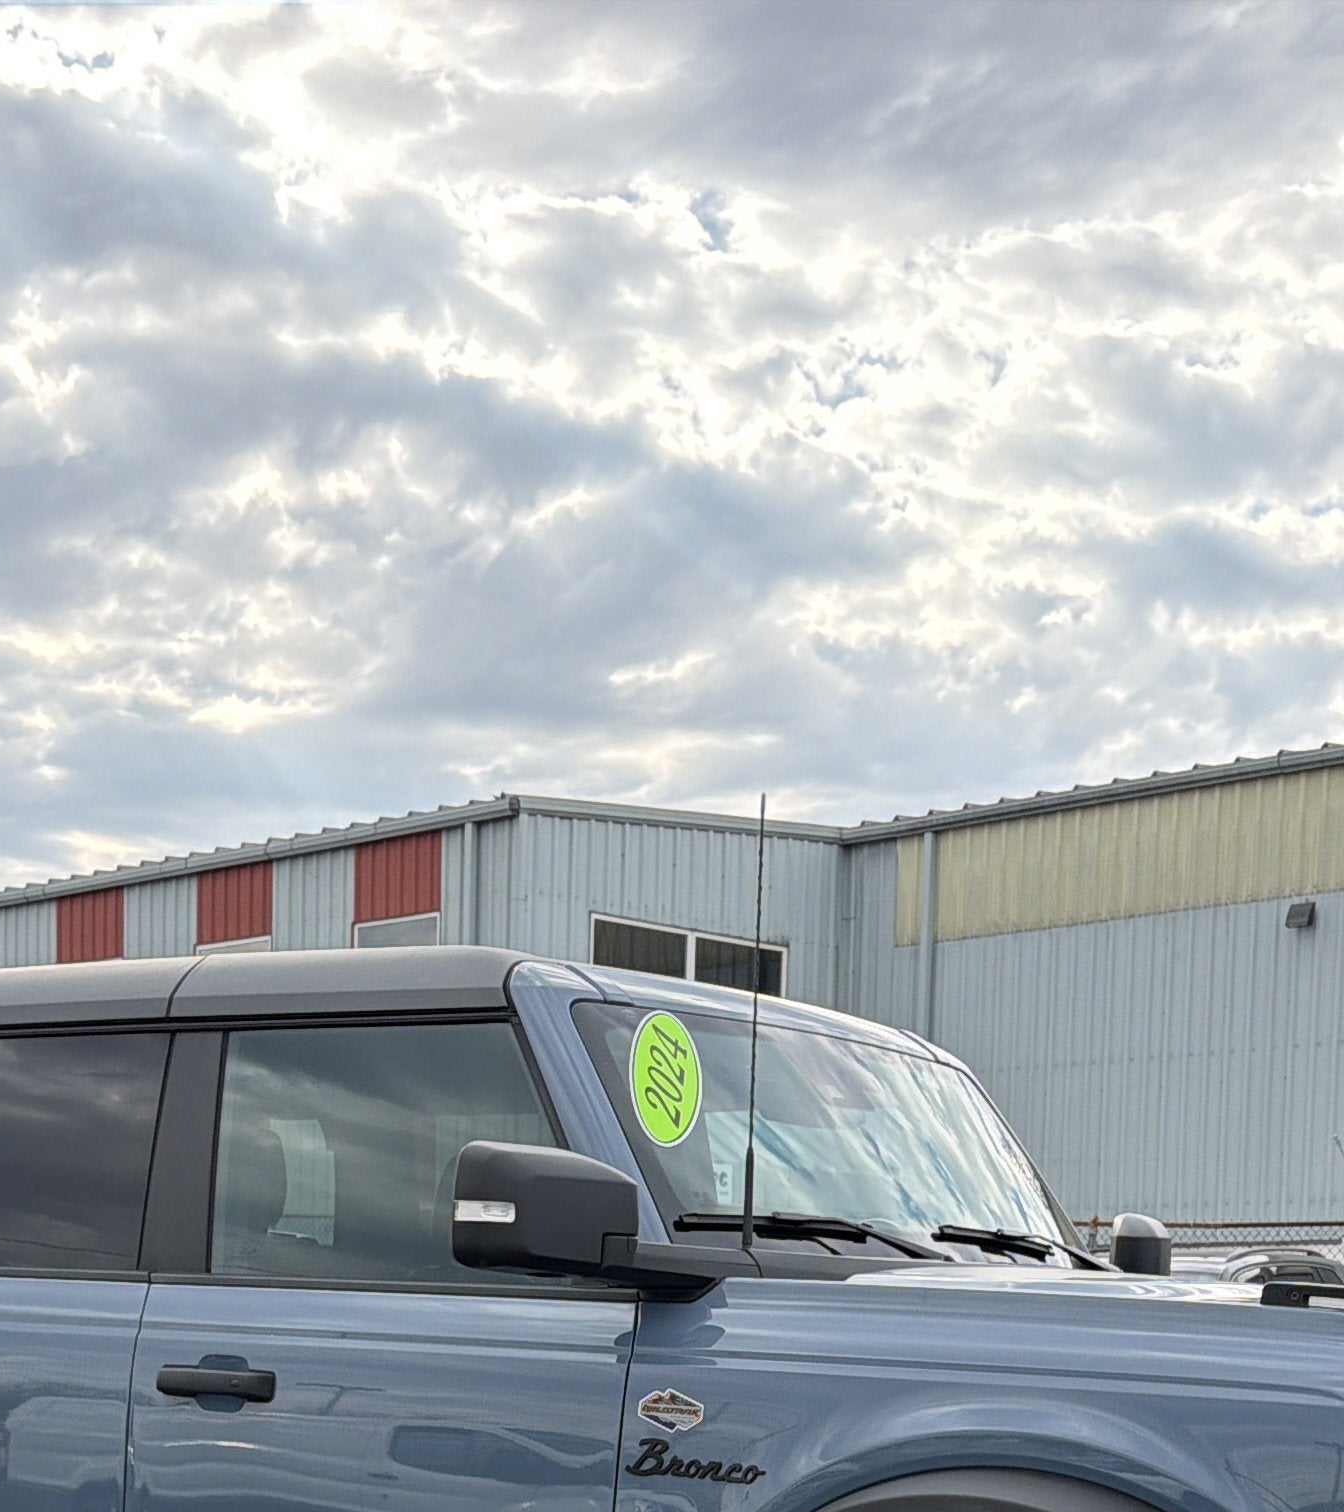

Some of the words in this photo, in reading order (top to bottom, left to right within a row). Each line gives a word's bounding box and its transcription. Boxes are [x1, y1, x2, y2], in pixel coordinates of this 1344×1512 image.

[644, 1023, 688, 1130] 2024
[642, 1404, 700, 1417] WILDTRAK
[625, 1438, 766, 1485] Bronco
